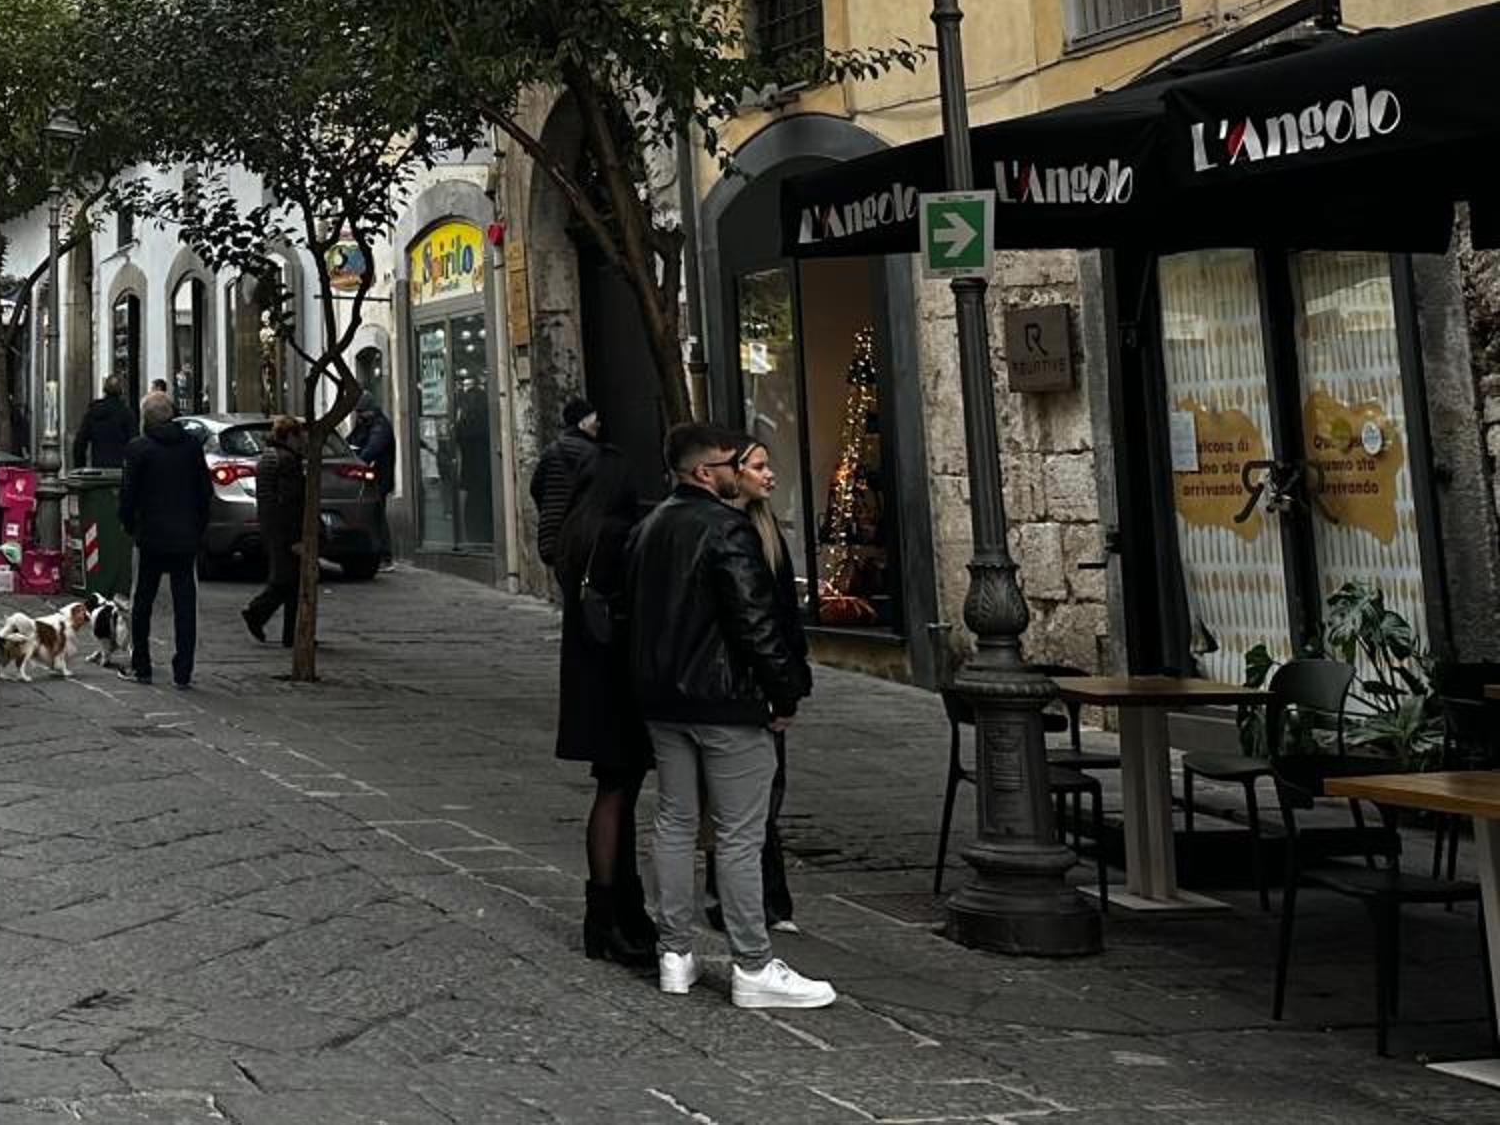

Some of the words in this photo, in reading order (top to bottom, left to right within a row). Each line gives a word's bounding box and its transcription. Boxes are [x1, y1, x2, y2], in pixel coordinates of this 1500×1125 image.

[1191, 85, 1401, 172] L'Angolo
[993, 159, 1133, 204] L'Angolo
[798, 182, 919, 244] L'Angolo
[1183, 480, 1242, 496] arrivando
